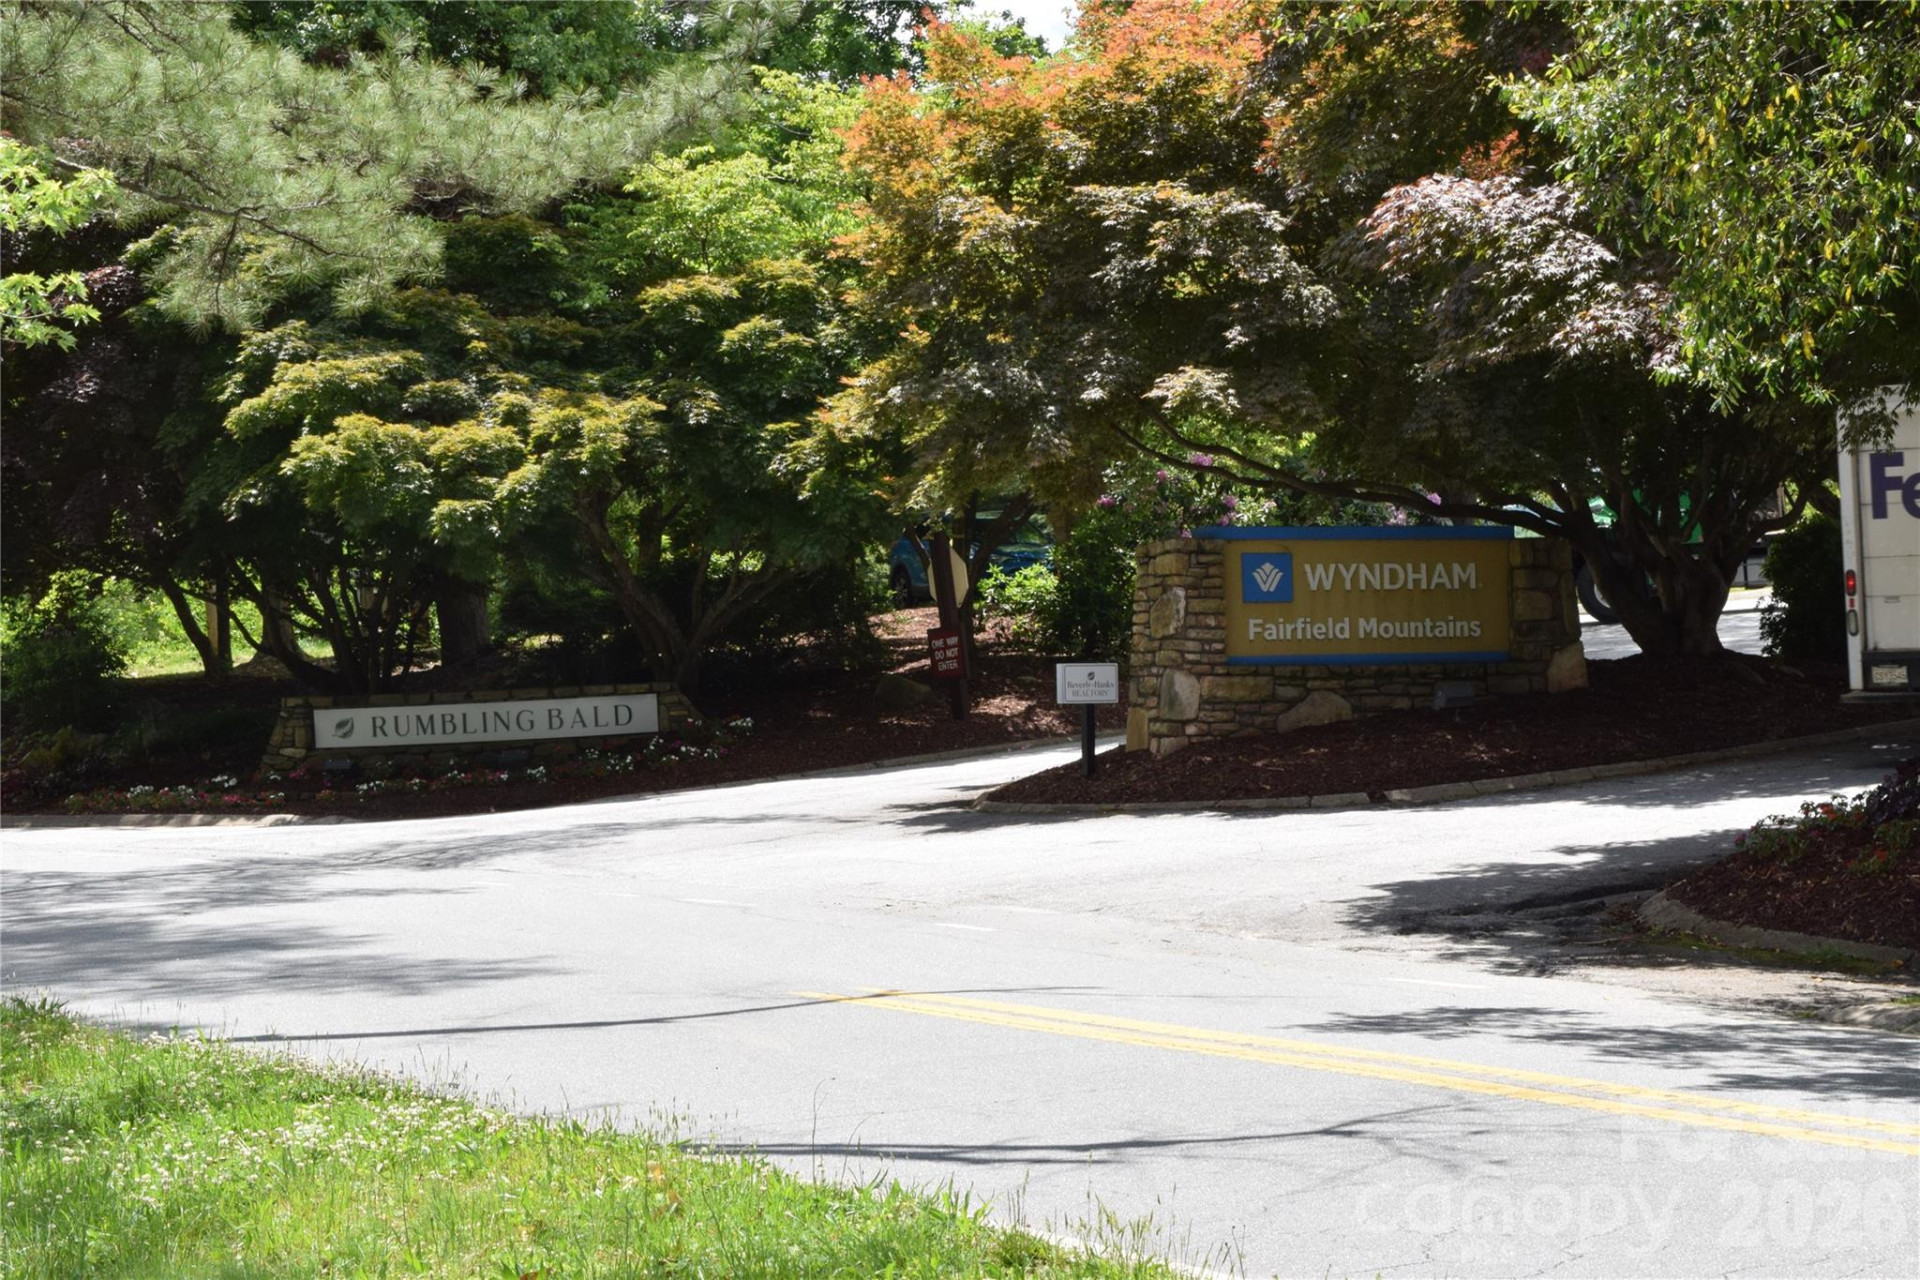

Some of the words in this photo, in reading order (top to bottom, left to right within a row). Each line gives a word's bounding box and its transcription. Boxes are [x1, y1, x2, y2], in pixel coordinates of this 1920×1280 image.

[1304, 562, 1477, 591] WYNDHAM
[1248, 616, 1350, 640] Fairfield
[1358, 616, 1482, 639] Mountains
[931, 638, 945, 649] ONE
[934, 650, 945, 660] DO
[945, 647, 958, 658] NOT
[937, 659, 959, 671] ENTER
[371, 709, 536, 738] RUMBLING
[548, 703, 634, 730] BALD
